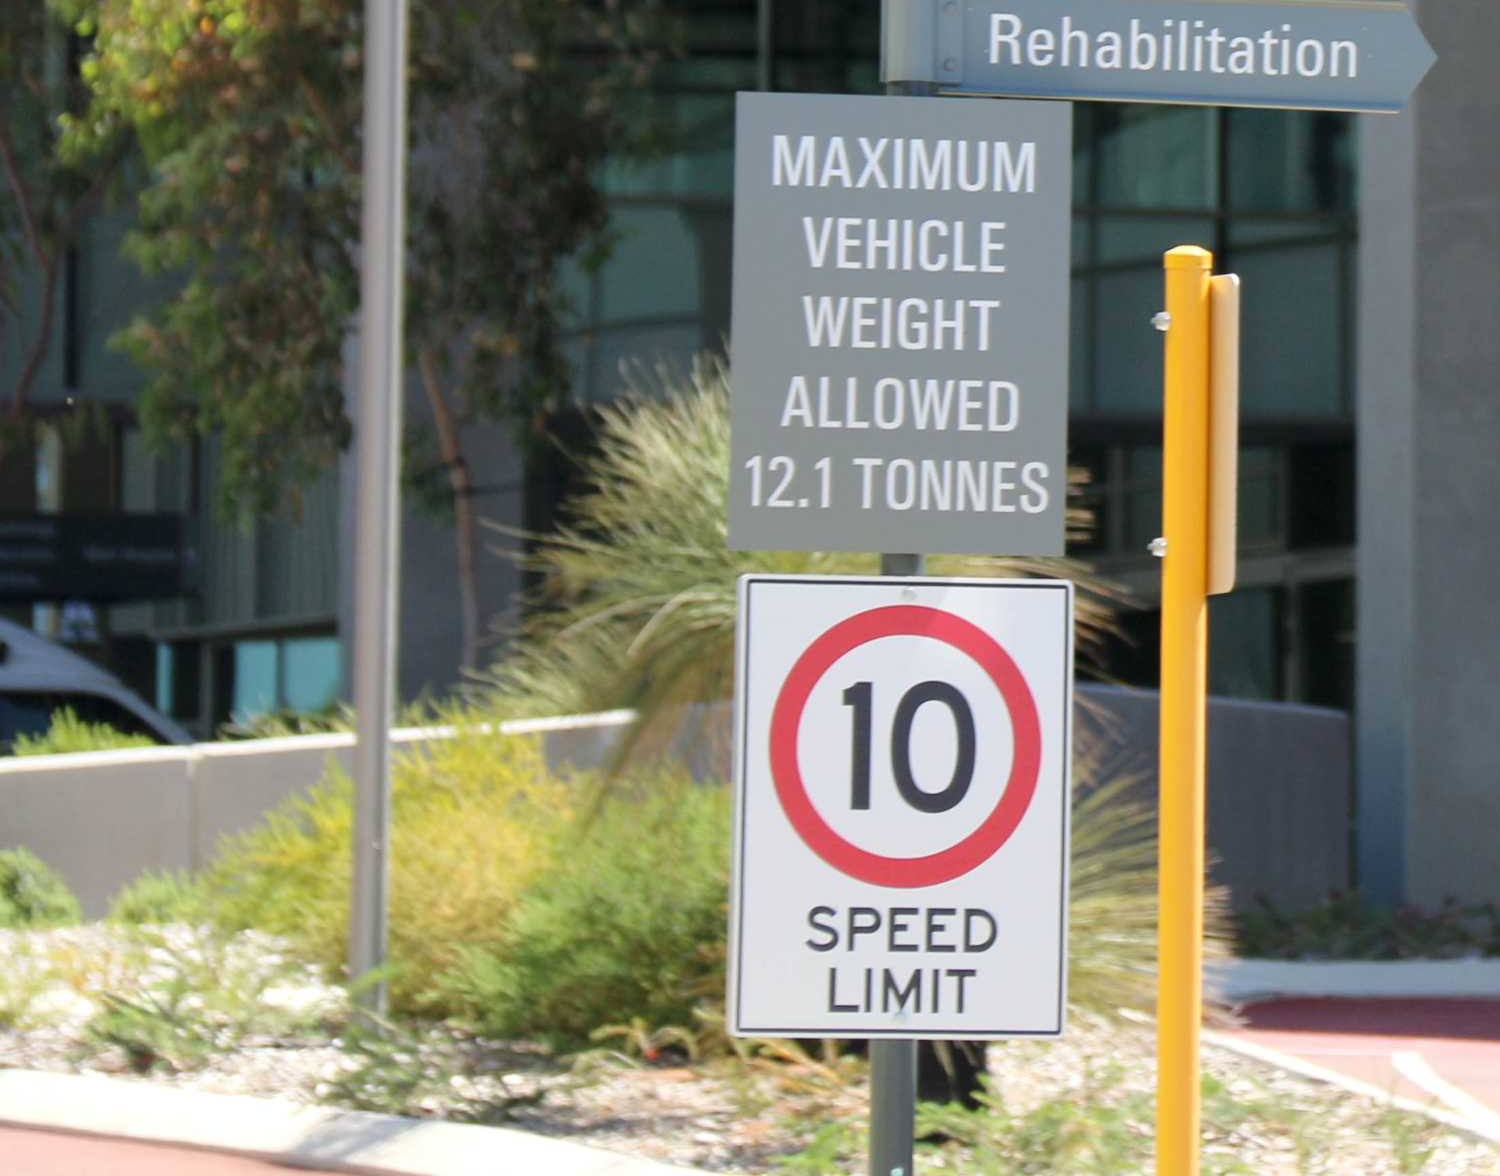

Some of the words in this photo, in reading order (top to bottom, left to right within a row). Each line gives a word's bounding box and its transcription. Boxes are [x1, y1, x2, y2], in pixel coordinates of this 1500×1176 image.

[988, 13, 1358, 78] Rehabilitation
[771, 134, 1037, 194] MAXIMUM
[802, 216, 1006, 273] VEHICLE
[802, 295, 1000, 352] WEIGHT
[780, 375, 1020, 433] ALLOWED
[744, 455, 832, 508] 12.1
[852, 457, 1050, 514] TONNES
[841, 679, 977, 814] 10
[805, 905, 998, 953] SPEED
[827, 967, 977, 1014] LIMIT
